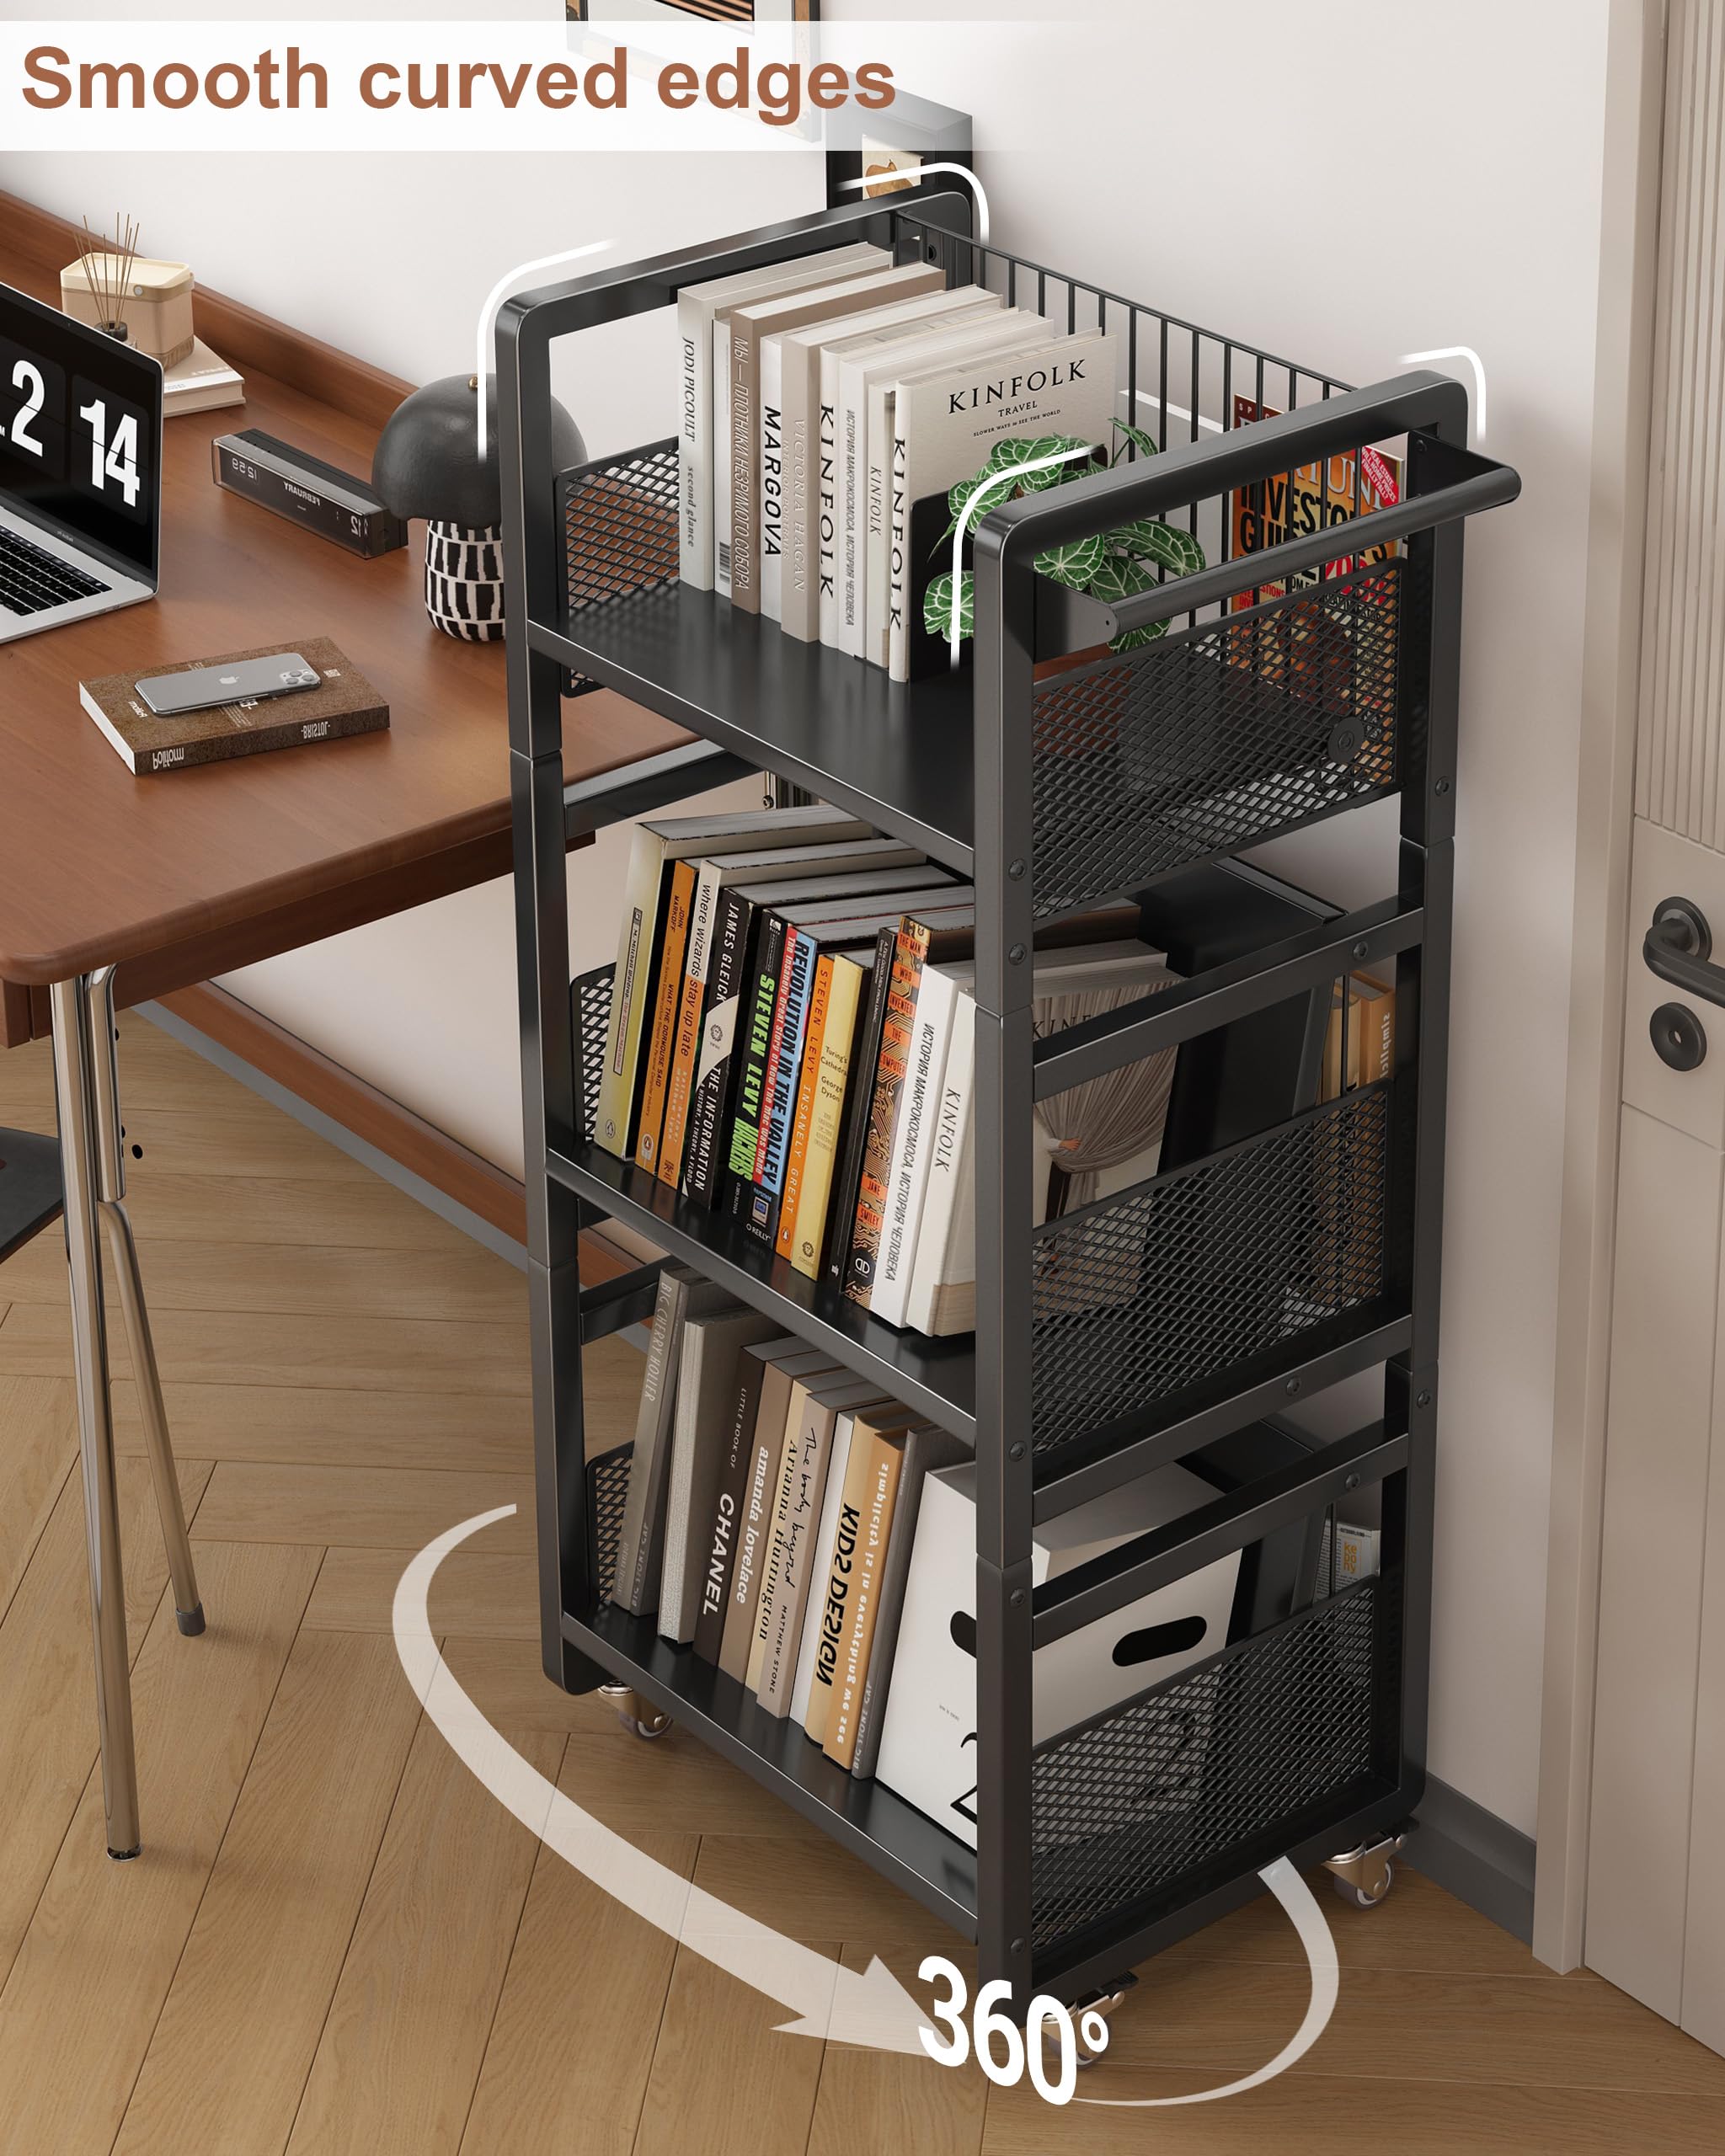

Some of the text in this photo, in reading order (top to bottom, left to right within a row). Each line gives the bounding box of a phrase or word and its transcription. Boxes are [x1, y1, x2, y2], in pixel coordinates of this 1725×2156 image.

[683, 337, 695, 442] JODI PICOULT
[948, 359, 1086, 414] KINFOLK
[973, 427, 995, 437] SLOWER
[1043, 409, 1061, 418] WORLD
[998, 401, 1038, 417] TRAVEL
[80, 399, 140, 507] 14
[764, 406, 782, 556] MARGOVA
[820, 403, 834, 599] KINFOLK
[870, 466, 882, 536] KINFOLK
[686, 466, 696, 547] second glance
[793, 419, 804, 592] VICTORIA HAGAN
[890, 439, 905, 631] KINFOLK
[671, 895, 680, 933] MARKOFF
[716, 902, 740, 1003] JAMES GLEICK
[787, 936, 796, 953] The
[900, 934, 921, 954] THE MAN
[681, 883, 711, 1057] where wizards stay up late
[781, 953, 793, 996] Insanely
[900, 967, 912, 980] WHO
[750, 974, 775, 1058] STEVEN
[777, 996, 788, 1021] Great
[782, 939, 809, 1054] REVOLUTION
[889, 992, 914, 1016] INVENTED
[771, 1021, 783, 1053] Story
[806, 969, 828, 1075] STEVEN LEVY
[891, 1027, 902, 1042] THE
[658, 1025, 669, 1069] DORMOUSE
[770, 1054, 779, 1067] of
[777, 1054, 793, 1079] IN
[820, 1056, 848, 1076] Cathedra
[826, 1046, 847, 1064] Turing's
[880, 1053, 906, 1076] COMPUTER
[917, 1022, 934, 1076] ИСТОРИЯ
[708, 1067, 721, 1091] THE
[742, 1063, 762, 1118] LEVY
[765, 1086, 775, 1103] The
[767, 1068, 777, 1086] How
[821, 1075, 843, 1093] George
[821, 1086, 841, 1102] Dyson
[761, 1105, 772, 1124] Mac
[771, 1081, 790, 1117] THE
[694, 1095, 716, 1192] INFORMATION
[729, 1117, 760, 1182] HACKERS
[759, 1126, 770, 1147] Was
[785, 1085, 811, 1214] INSANELY GREAT
[934, 1087, 961, 1172] KINFOLK
[755, 1149, 767, 1175] Made
[762, 1118, 785, 1186] VALLEY
[868, 1182, 880, 1196] JANE
[895, 1169, 911, 1225] ИСТОРИЯ
[860, 1208, 879, 1226] SMILEY
[884, 1225, 904, 1282] ЧЕЛОВЕКА
[644, 1282, 672, 1401] BIG CHERRY HOLLER
[729, 1388, 747, 1470] LITTLE BOOK OF
[803, 1428, 817, 1465] The
[777, 1439, 798, 1521] Arianna
[736, 1446, 769, 1604] amanda lovelace
[636, 1547, 644, 1583] STONE
[703, 1493, 734, 1615] CHANEL
[769, 1605, 788, 1694] MATTHEW STONE
[857, 1710, 868, 1744] STONE
